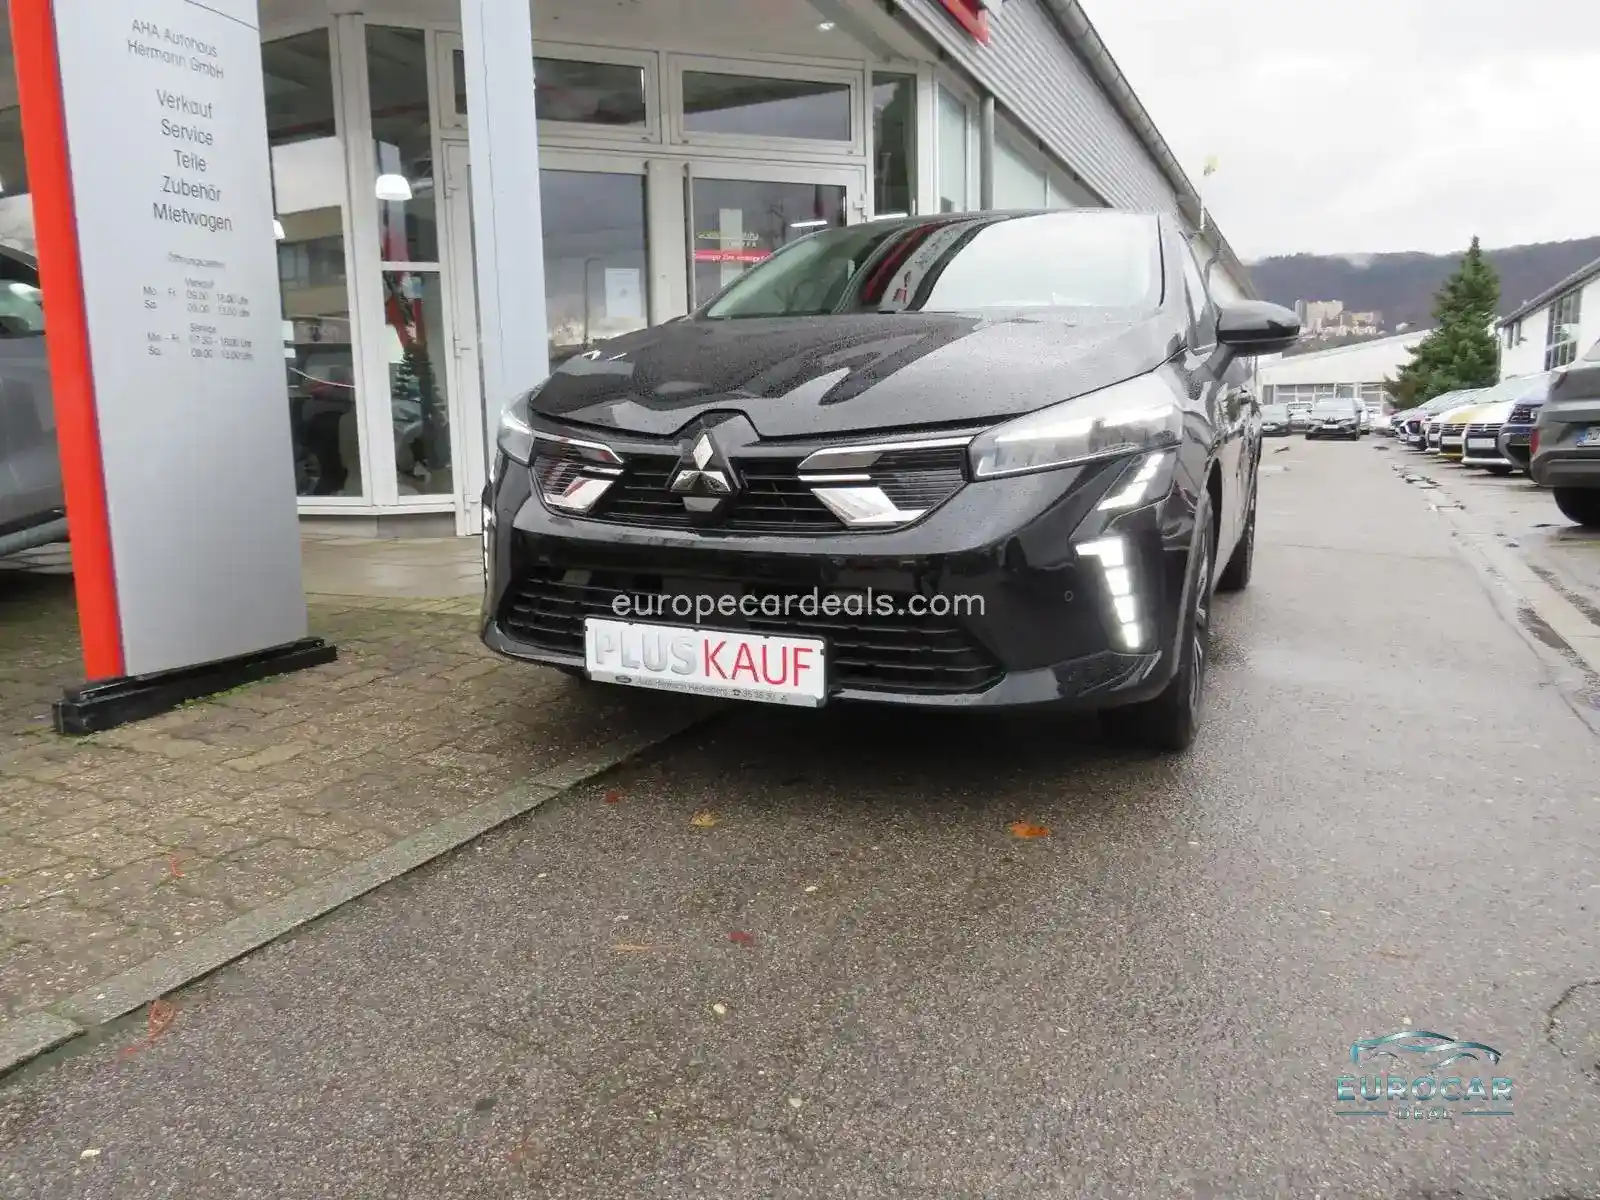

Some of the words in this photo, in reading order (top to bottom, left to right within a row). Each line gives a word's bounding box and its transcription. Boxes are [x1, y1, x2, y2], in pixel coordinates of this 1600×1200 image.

[132, 19, 159, 38] AHA
[164, 29, 218, 58] Autohaus
[127, 40, 186, 68] Hermann
[191, 56, 224, 79] GmbH
[156, 88, 213, 119] Verkauf
[161, 118, 214, 146] Service
[173, 149, 207, 172] Teile
[163, 175, 221, 202] Zubehör
[153, 202, 233, 233] Mietwagen
